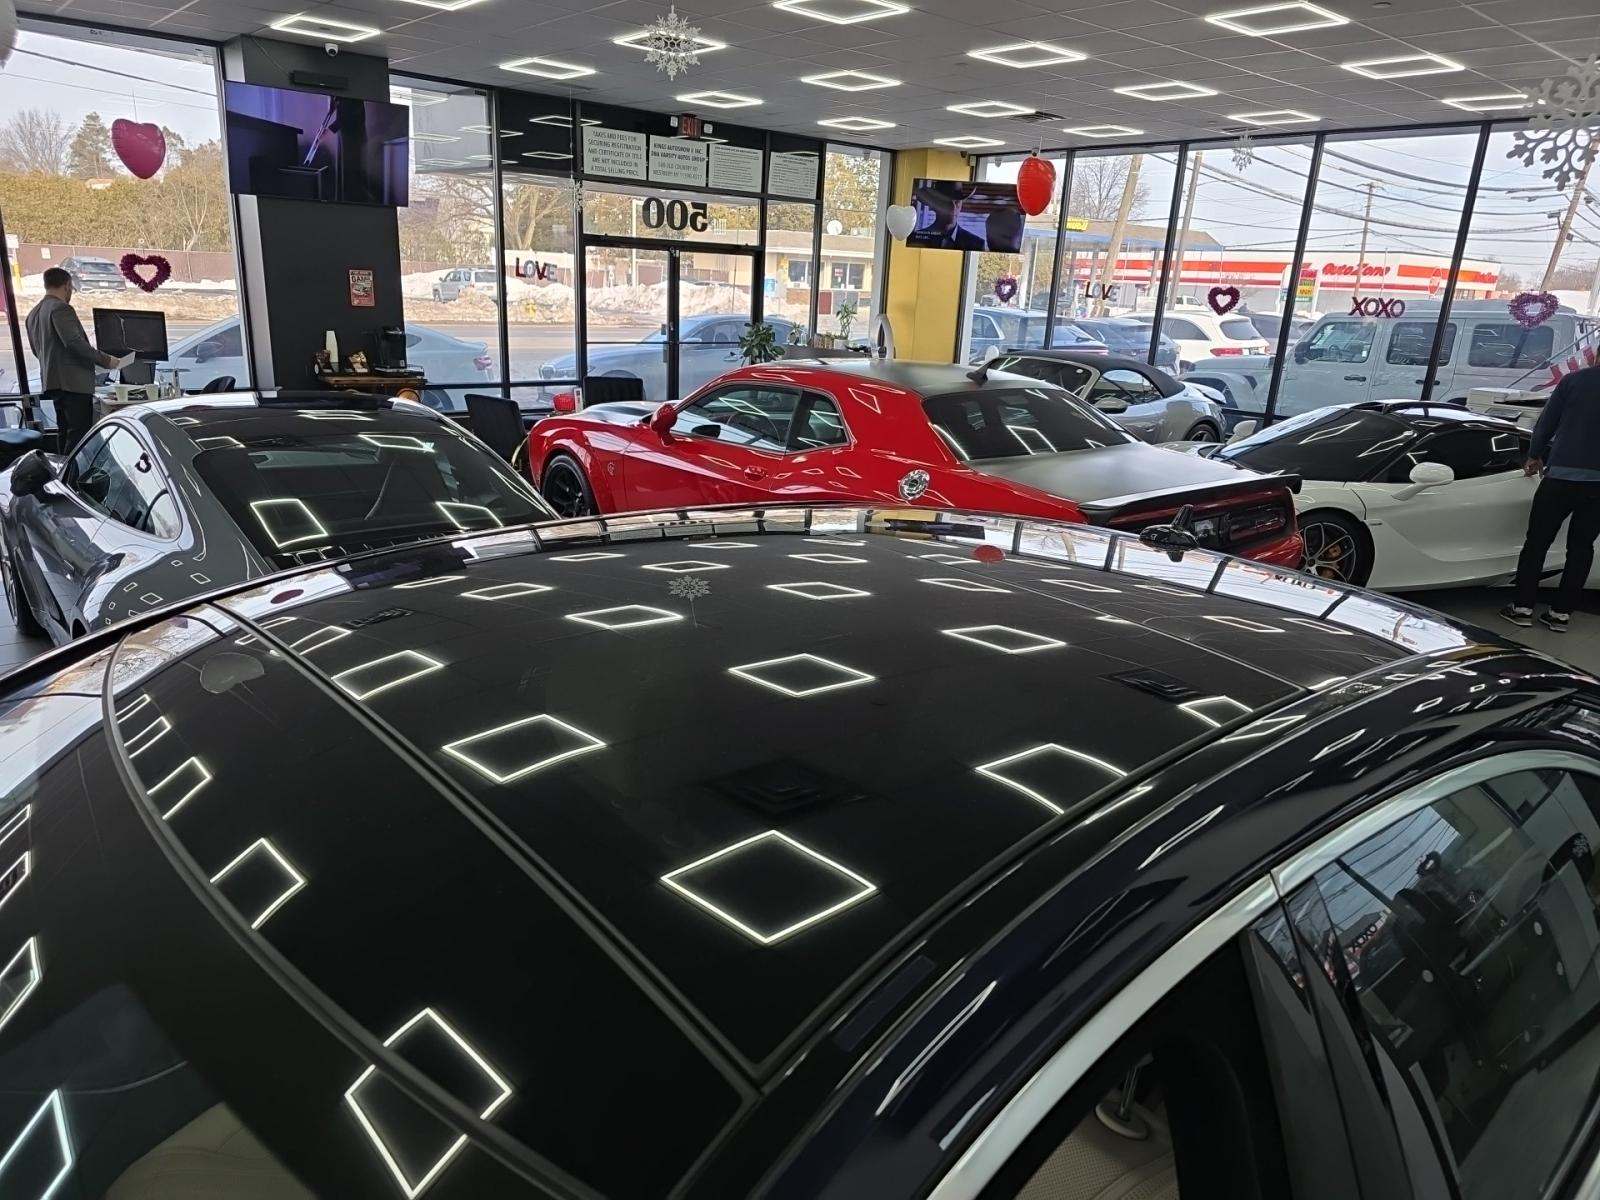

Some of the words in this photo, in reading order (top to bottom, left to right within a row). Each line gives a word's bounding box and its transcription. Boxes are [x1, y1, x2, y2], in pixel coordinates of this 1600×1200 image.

[683, 117, 698, 136] EXIT
[588, 139, 610, 147] SECURING
[611, 142, 641, 151] REGISTRATION
[599, 149, 624, 158] CERTIFICATE
[515, 257, 557, 281] LOVE
[1085, 281, 1120, 302] LOVE
[1348, 296, 1405, 318] XOXO
